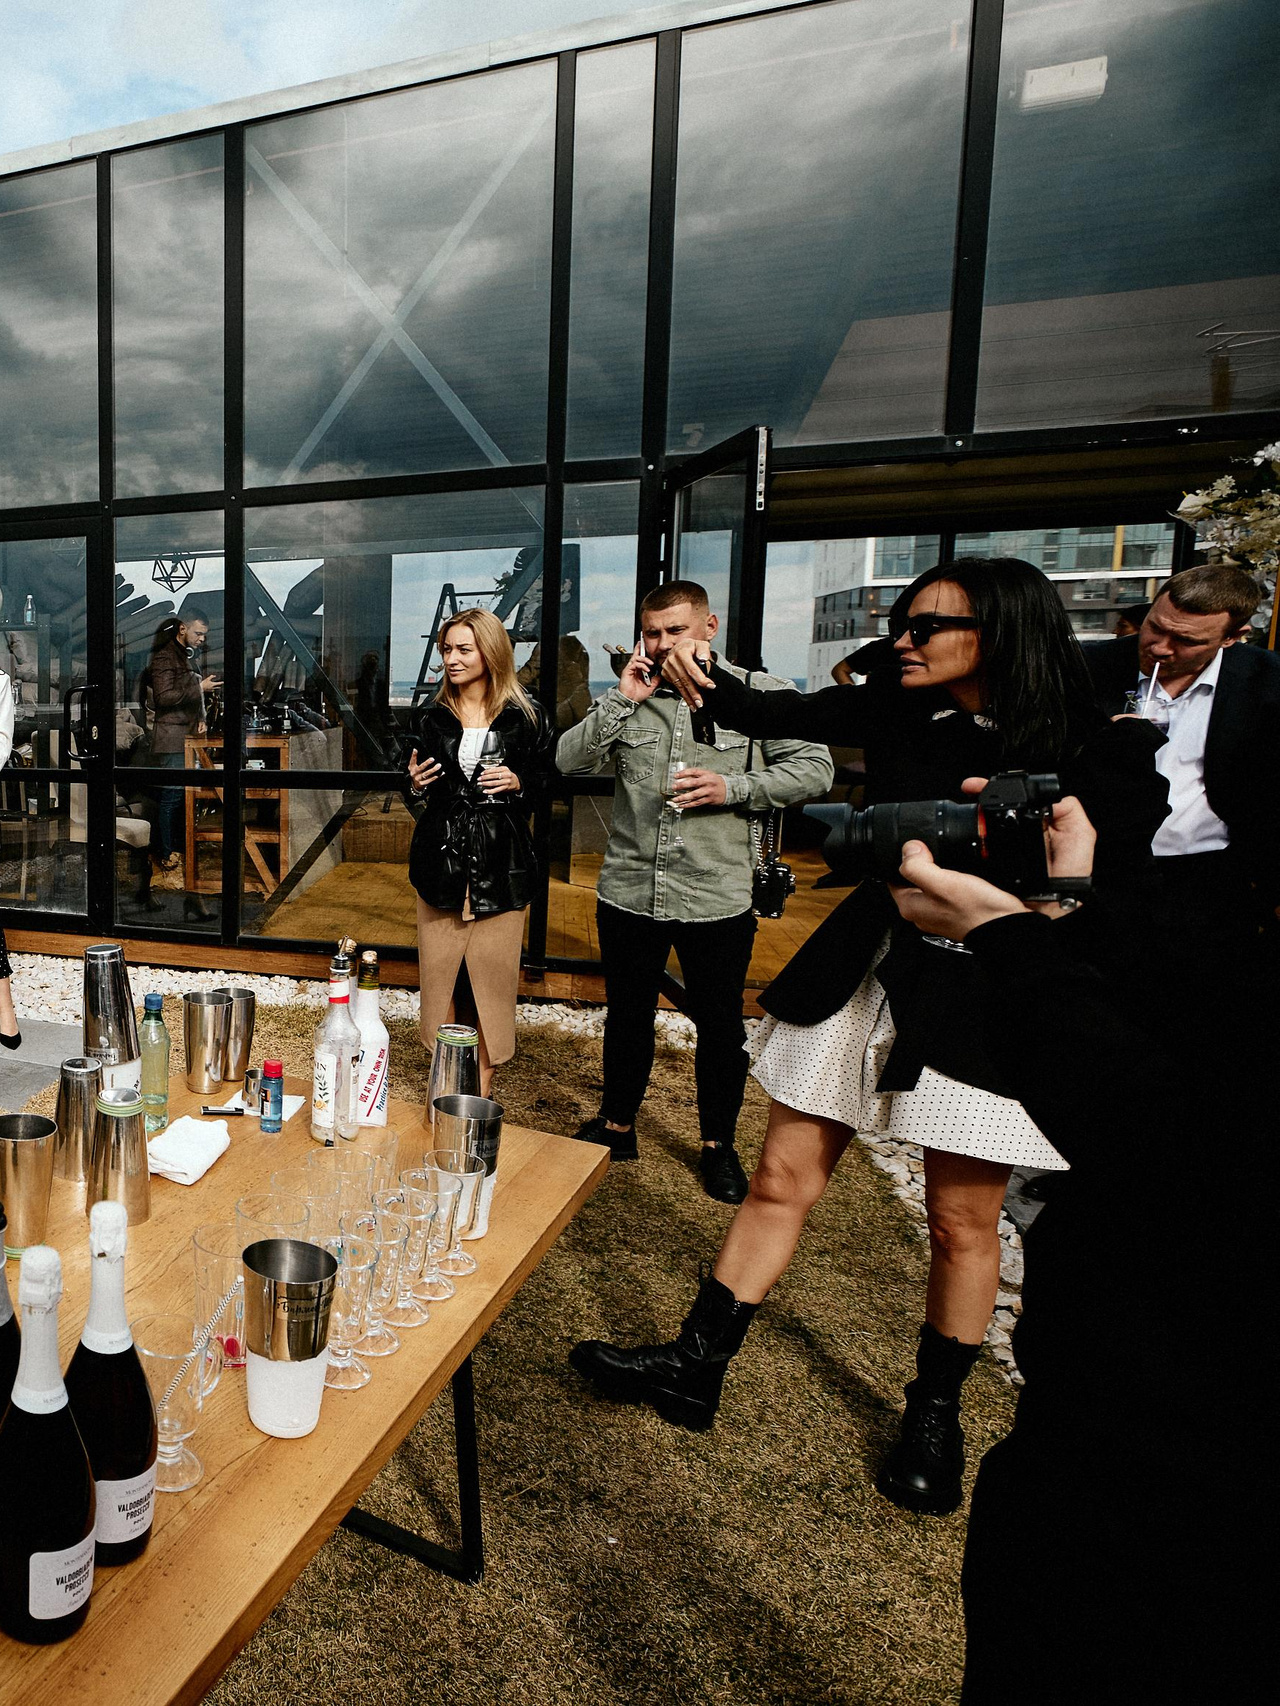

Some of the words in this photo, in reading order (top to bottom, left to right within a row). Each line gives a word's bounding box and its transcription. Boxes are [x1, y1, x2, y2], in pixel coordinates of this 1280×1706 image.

[359, 1093, 369, 1103] USE
[366, 1073, 378, 1086] YOUR
[373, 1060, 383, 1072] OWN
[376, 1087, 388, 1112] Practice
